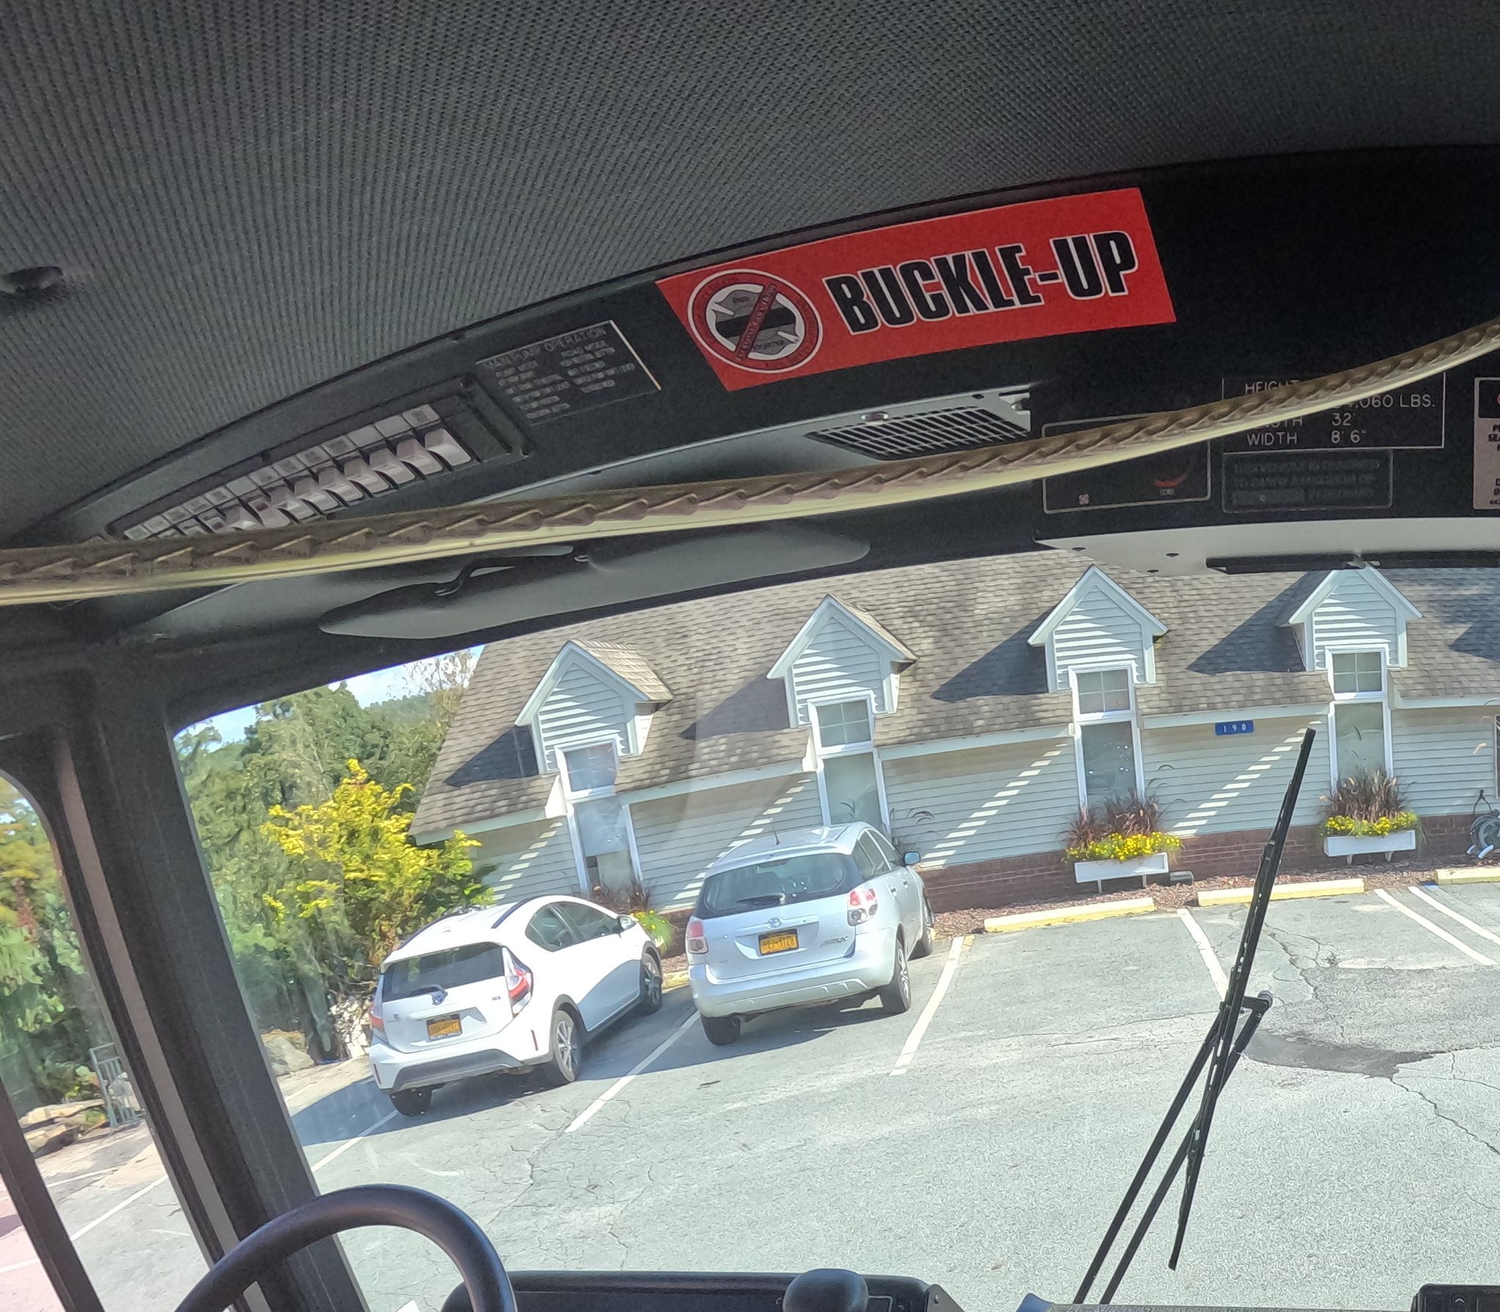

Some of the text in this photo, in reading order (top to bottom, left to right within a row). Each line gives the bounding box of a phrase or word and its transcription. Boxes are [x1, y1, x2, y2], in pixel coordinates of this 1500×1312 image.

[823, 230, 1137, 334] BUCKLE-UP
[1399, 395, 1436, 409] LBS.
[1247, 430, 1298, 446] WIDTH
